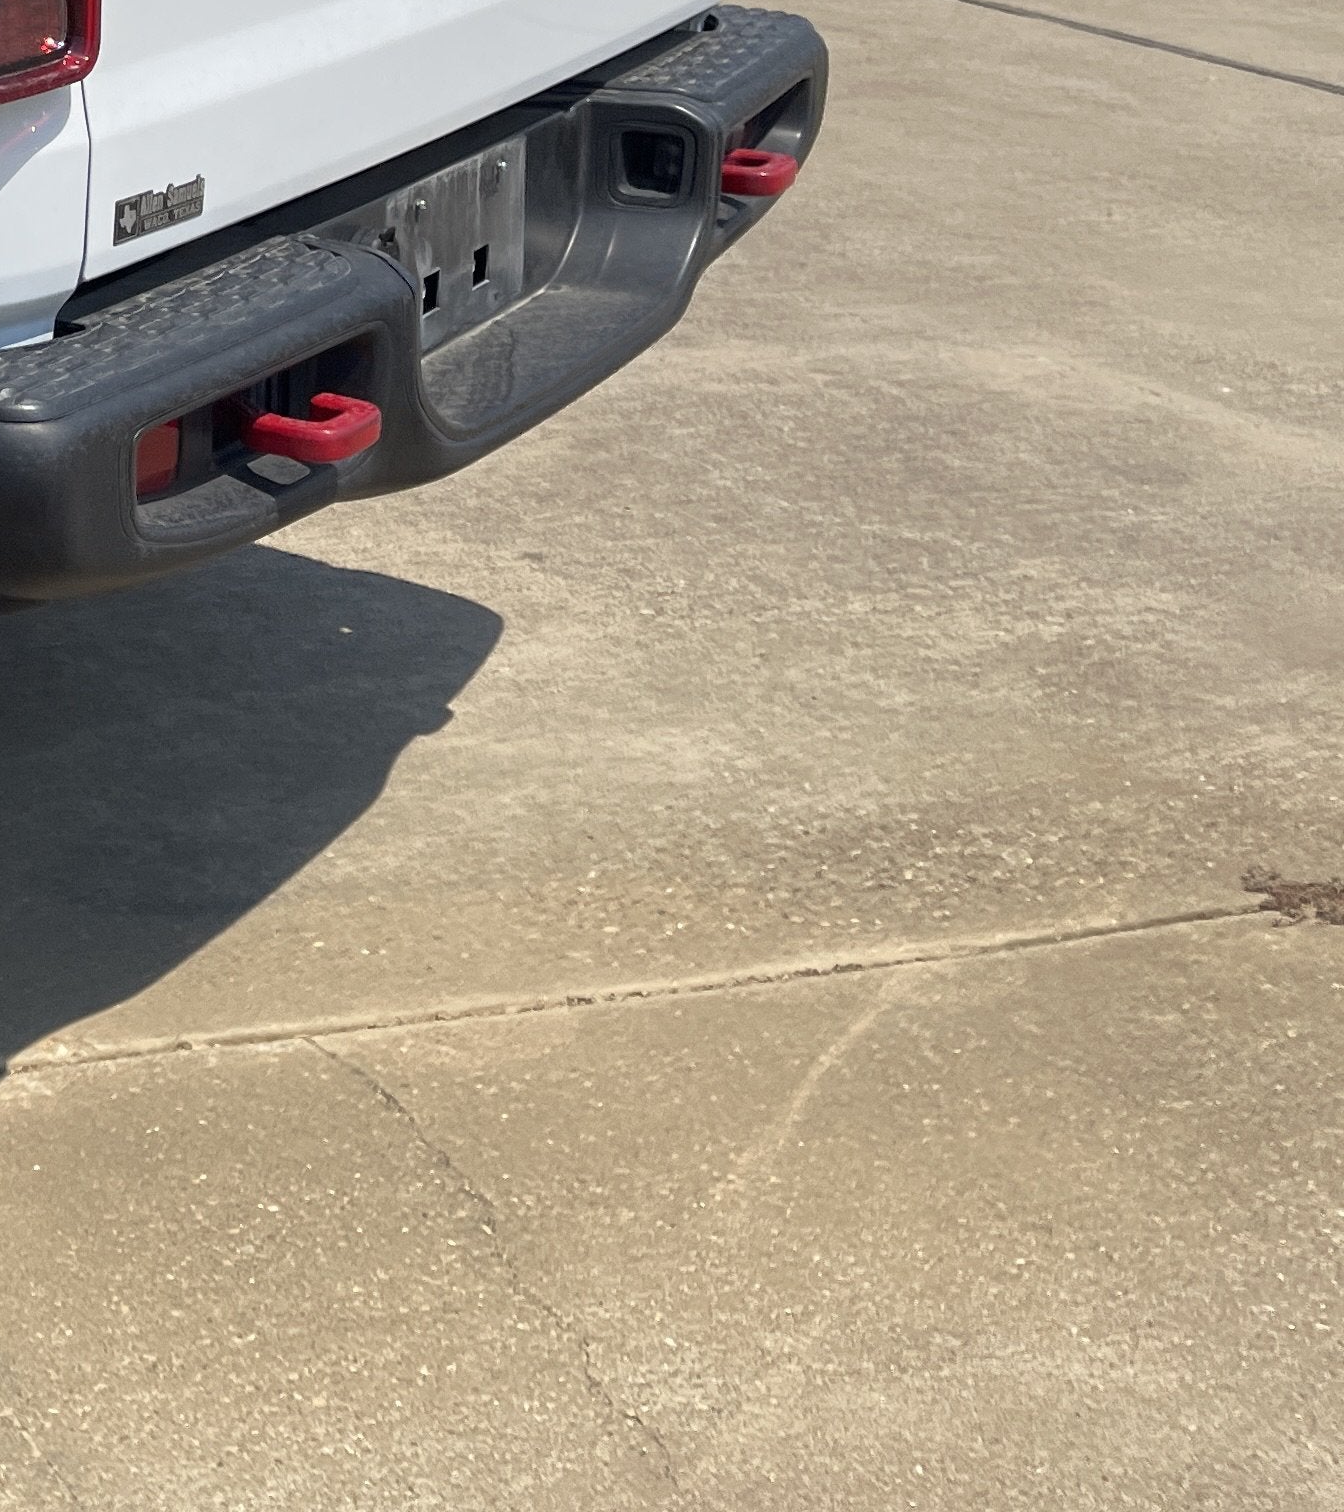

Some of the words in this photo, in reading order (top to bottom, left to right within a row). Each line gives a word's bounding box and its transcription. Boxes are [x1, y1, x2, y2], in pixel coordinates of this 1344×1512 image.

[141, 193, 164, 215] Allen
[167, 178, 205, 207] Samuels
[174, 201, 202, 220] TEXAS
